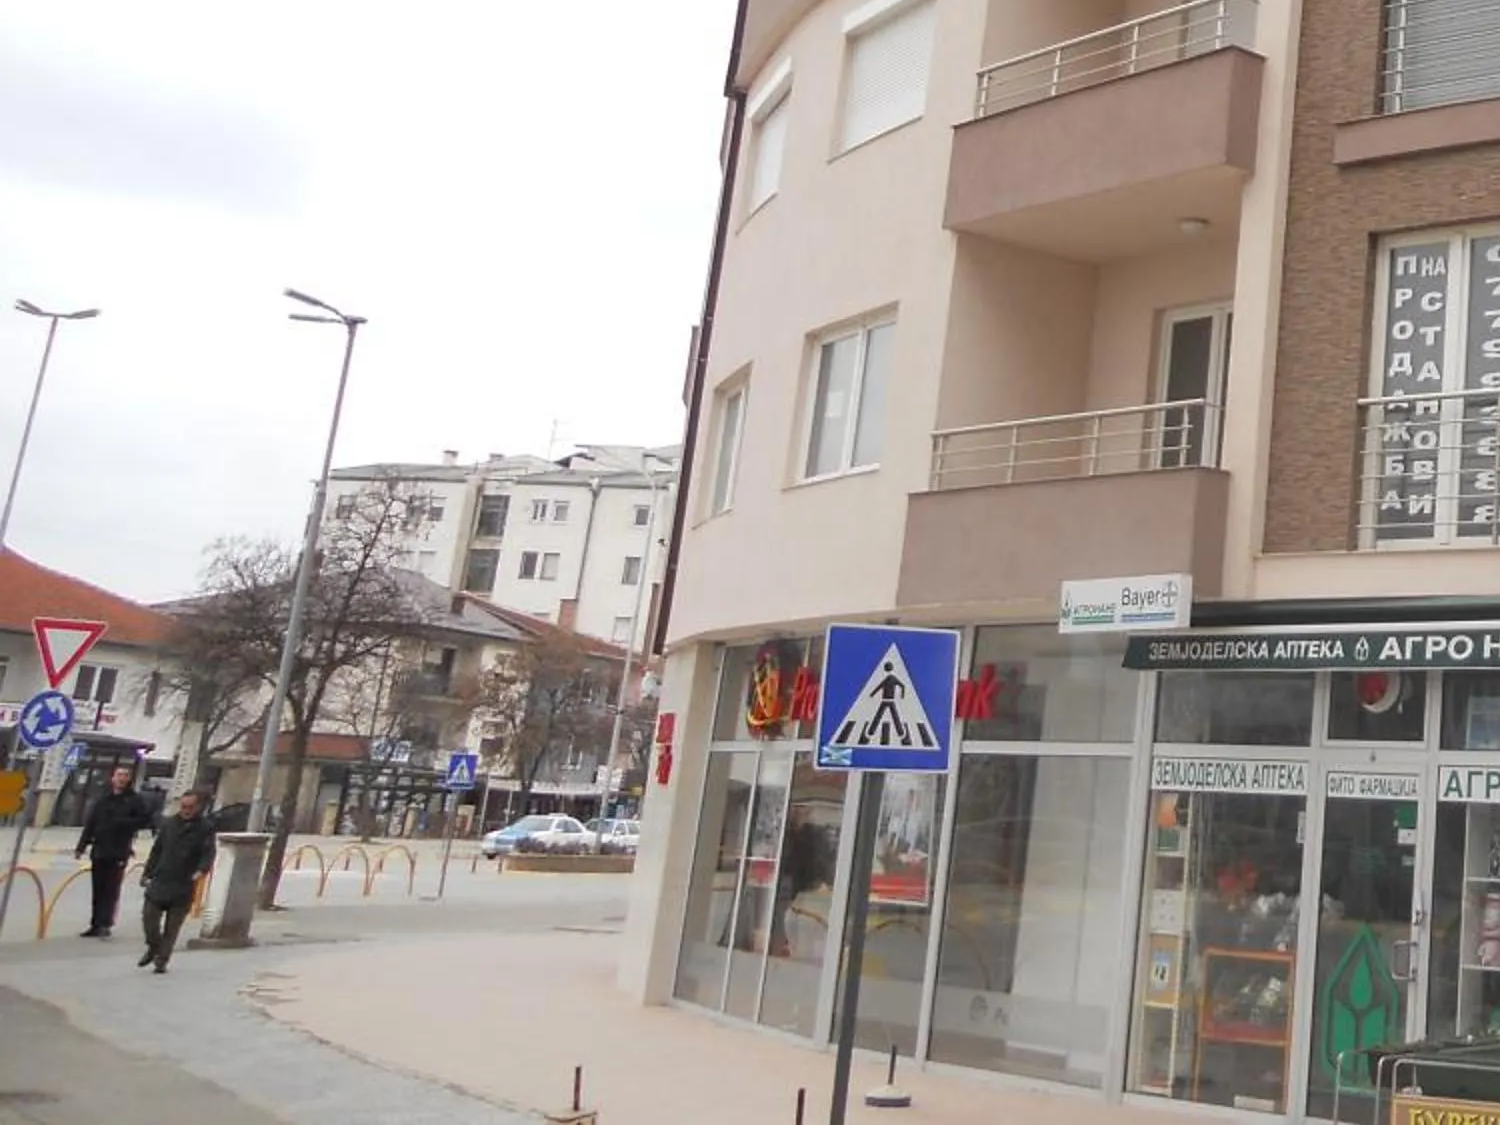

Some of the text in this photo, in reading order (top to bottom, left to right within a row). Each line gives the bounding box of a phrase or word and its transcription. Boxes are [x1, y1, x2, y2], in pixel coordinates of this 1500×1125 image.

[1421, 256, 1447, 277] НА
[1121, 587, 1161, 611] Bayer
[1149, 641, 1270, 661] ЗЕМЈОДЕЛСКА
[1273, 639, 1345, 660] АПТЕКА
[1379, 636, 1474, 661] АГРО
[1155, 759, 1306, 791] ЗЕМЈОДЕЛСКА АПТЕКА
